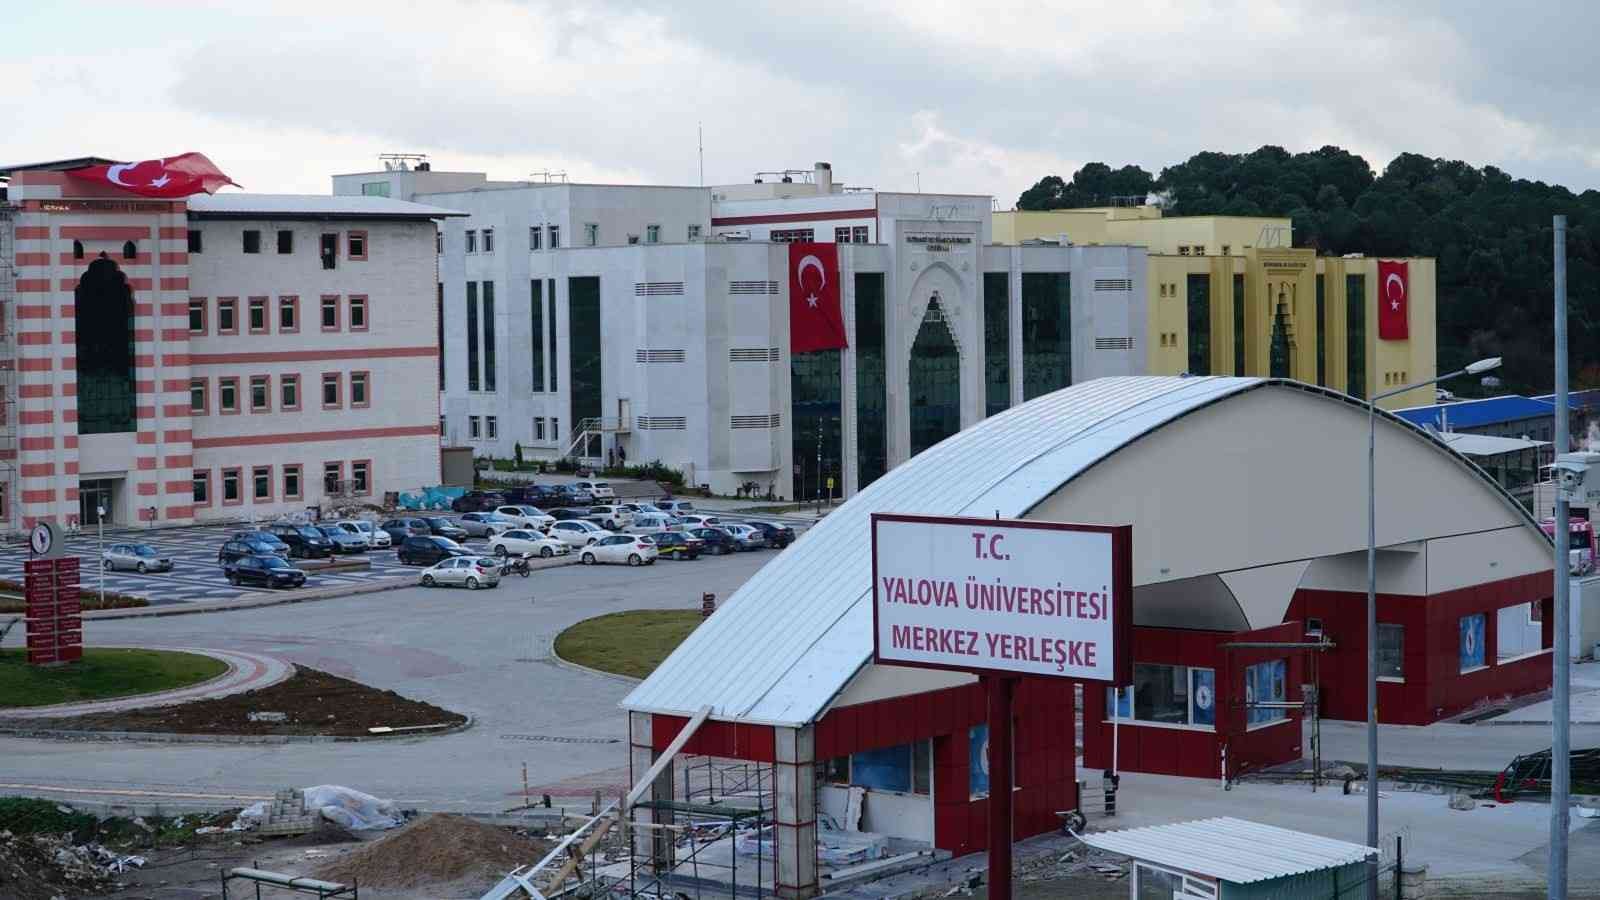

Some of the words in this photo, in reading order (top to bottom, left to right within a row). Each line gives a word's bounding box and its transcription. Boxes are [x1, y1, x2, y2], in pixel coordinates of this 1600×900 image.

[972, 532, 1010, 561] T.C.
[883, 577, 959, 608] YALOVA
[966, 576, 1108, 620] ÜNİVERSİTESİ
[892, 625, 979, 656] MERKEZ
[985, 633, 1097, 672] YERLEŞKE
